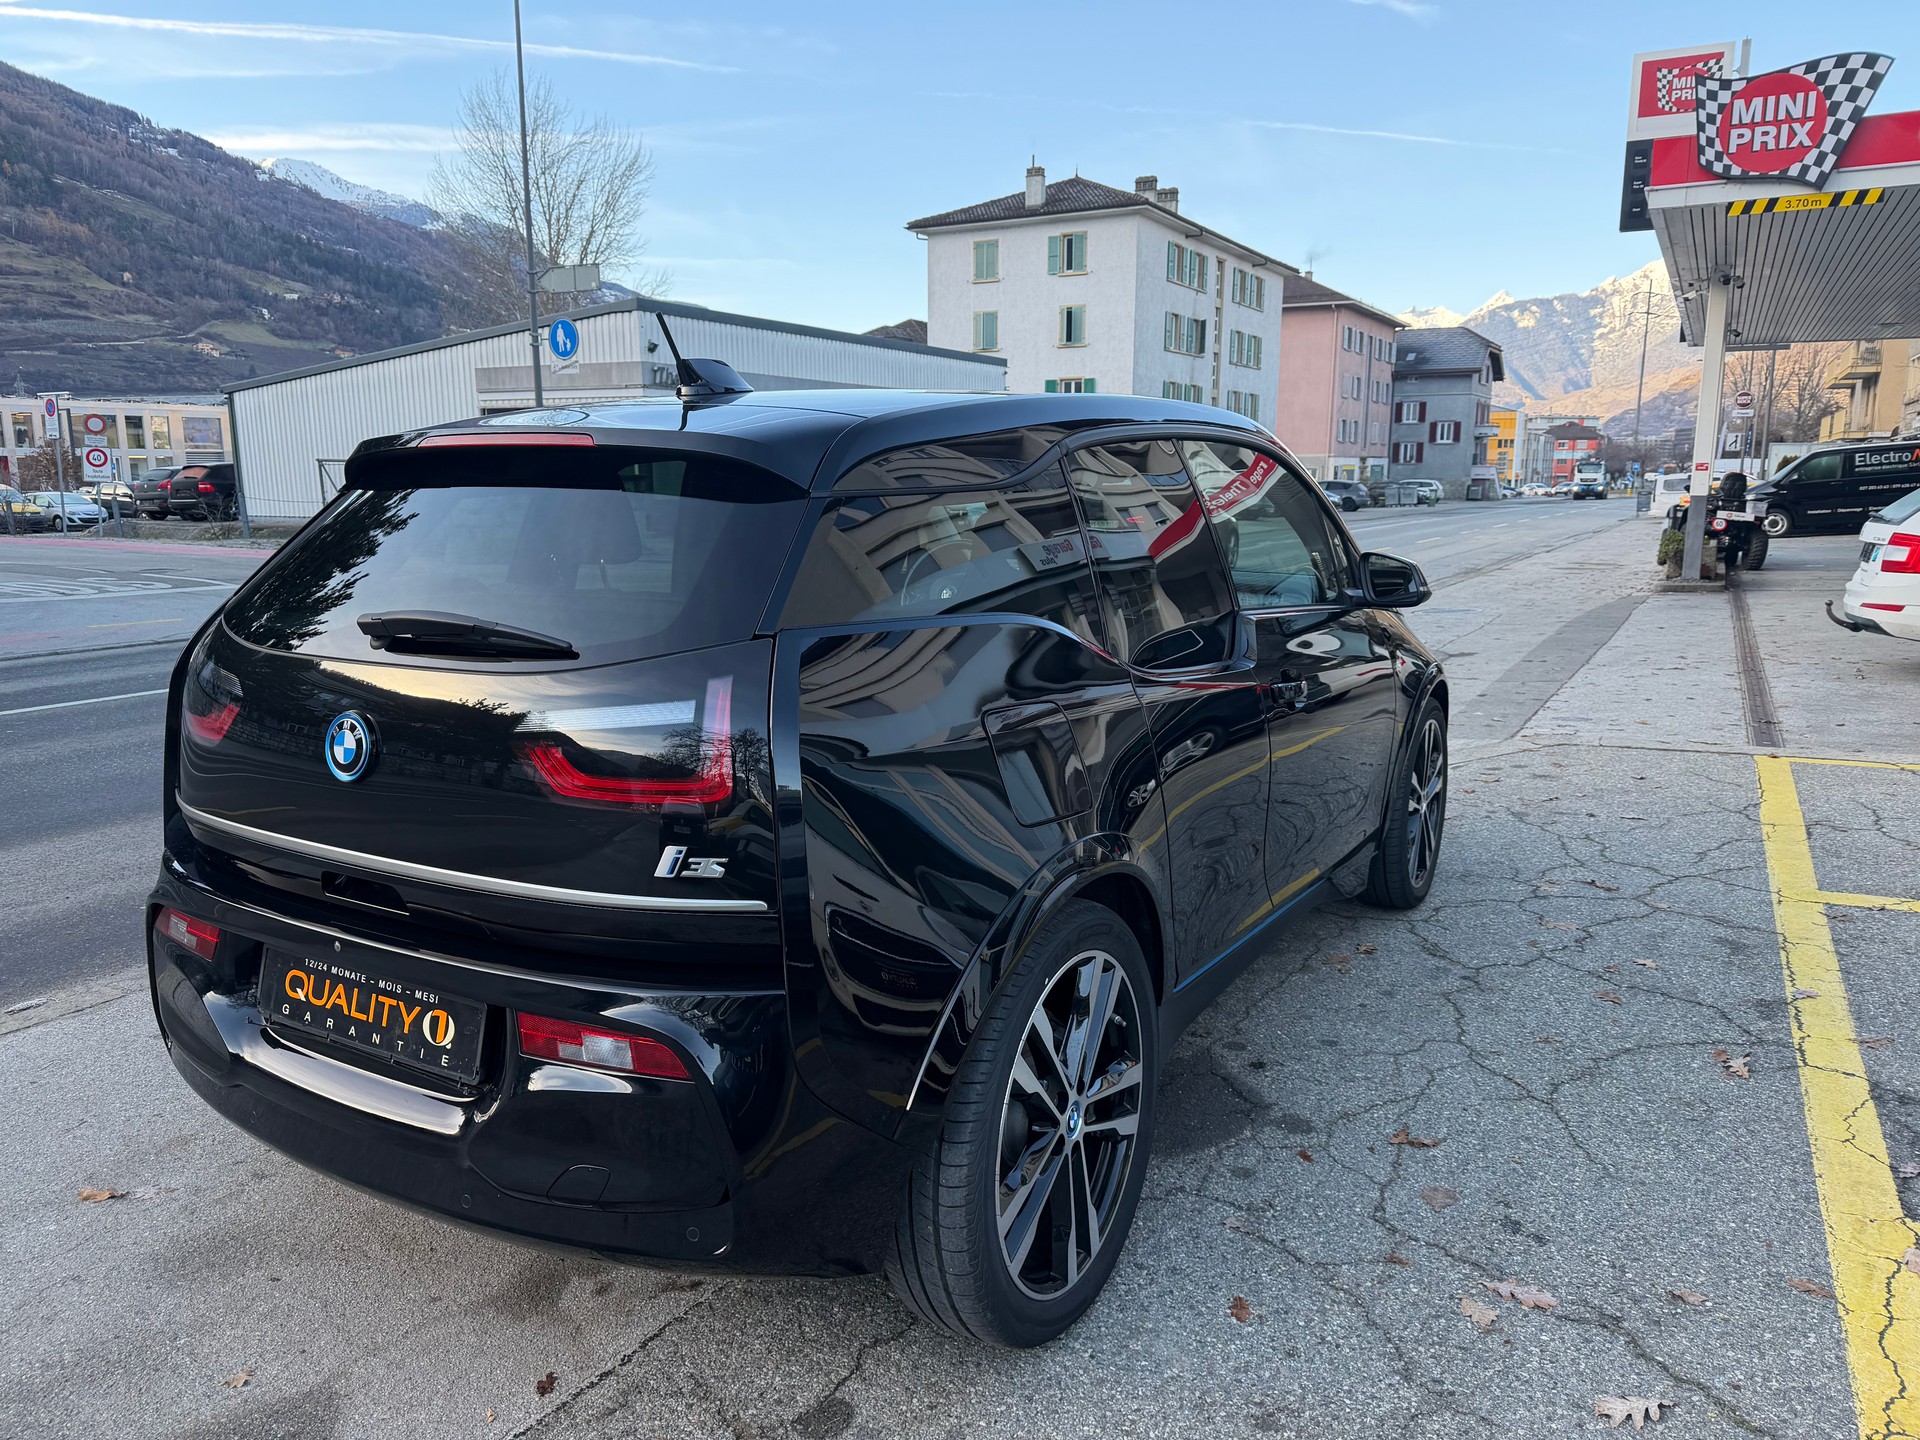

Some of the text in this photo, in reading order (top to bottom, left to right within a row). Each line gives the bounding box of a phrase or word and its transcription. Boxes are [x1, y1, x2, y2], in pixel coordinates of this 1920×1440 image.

[1671, 88, 1696, 101] PRI
[1673, 75, 1696, 89] MI
[1731, 91, 1817, 126] MINI
[1728, 121, 1815, 154] PRIX
[92, 454, 102, 462] 40
[332, 720, 362, 740] BMW
[305, 958, 328, 972] 12/24
[331, 966, 366, 984] MONATE
[378, 979, 402, 995] MOIS
[415, 989, 439, 1004] MESI
[285, 969, 421, 1034] QUALITY
[282, 1003, 449, 1067] GARANTIE
